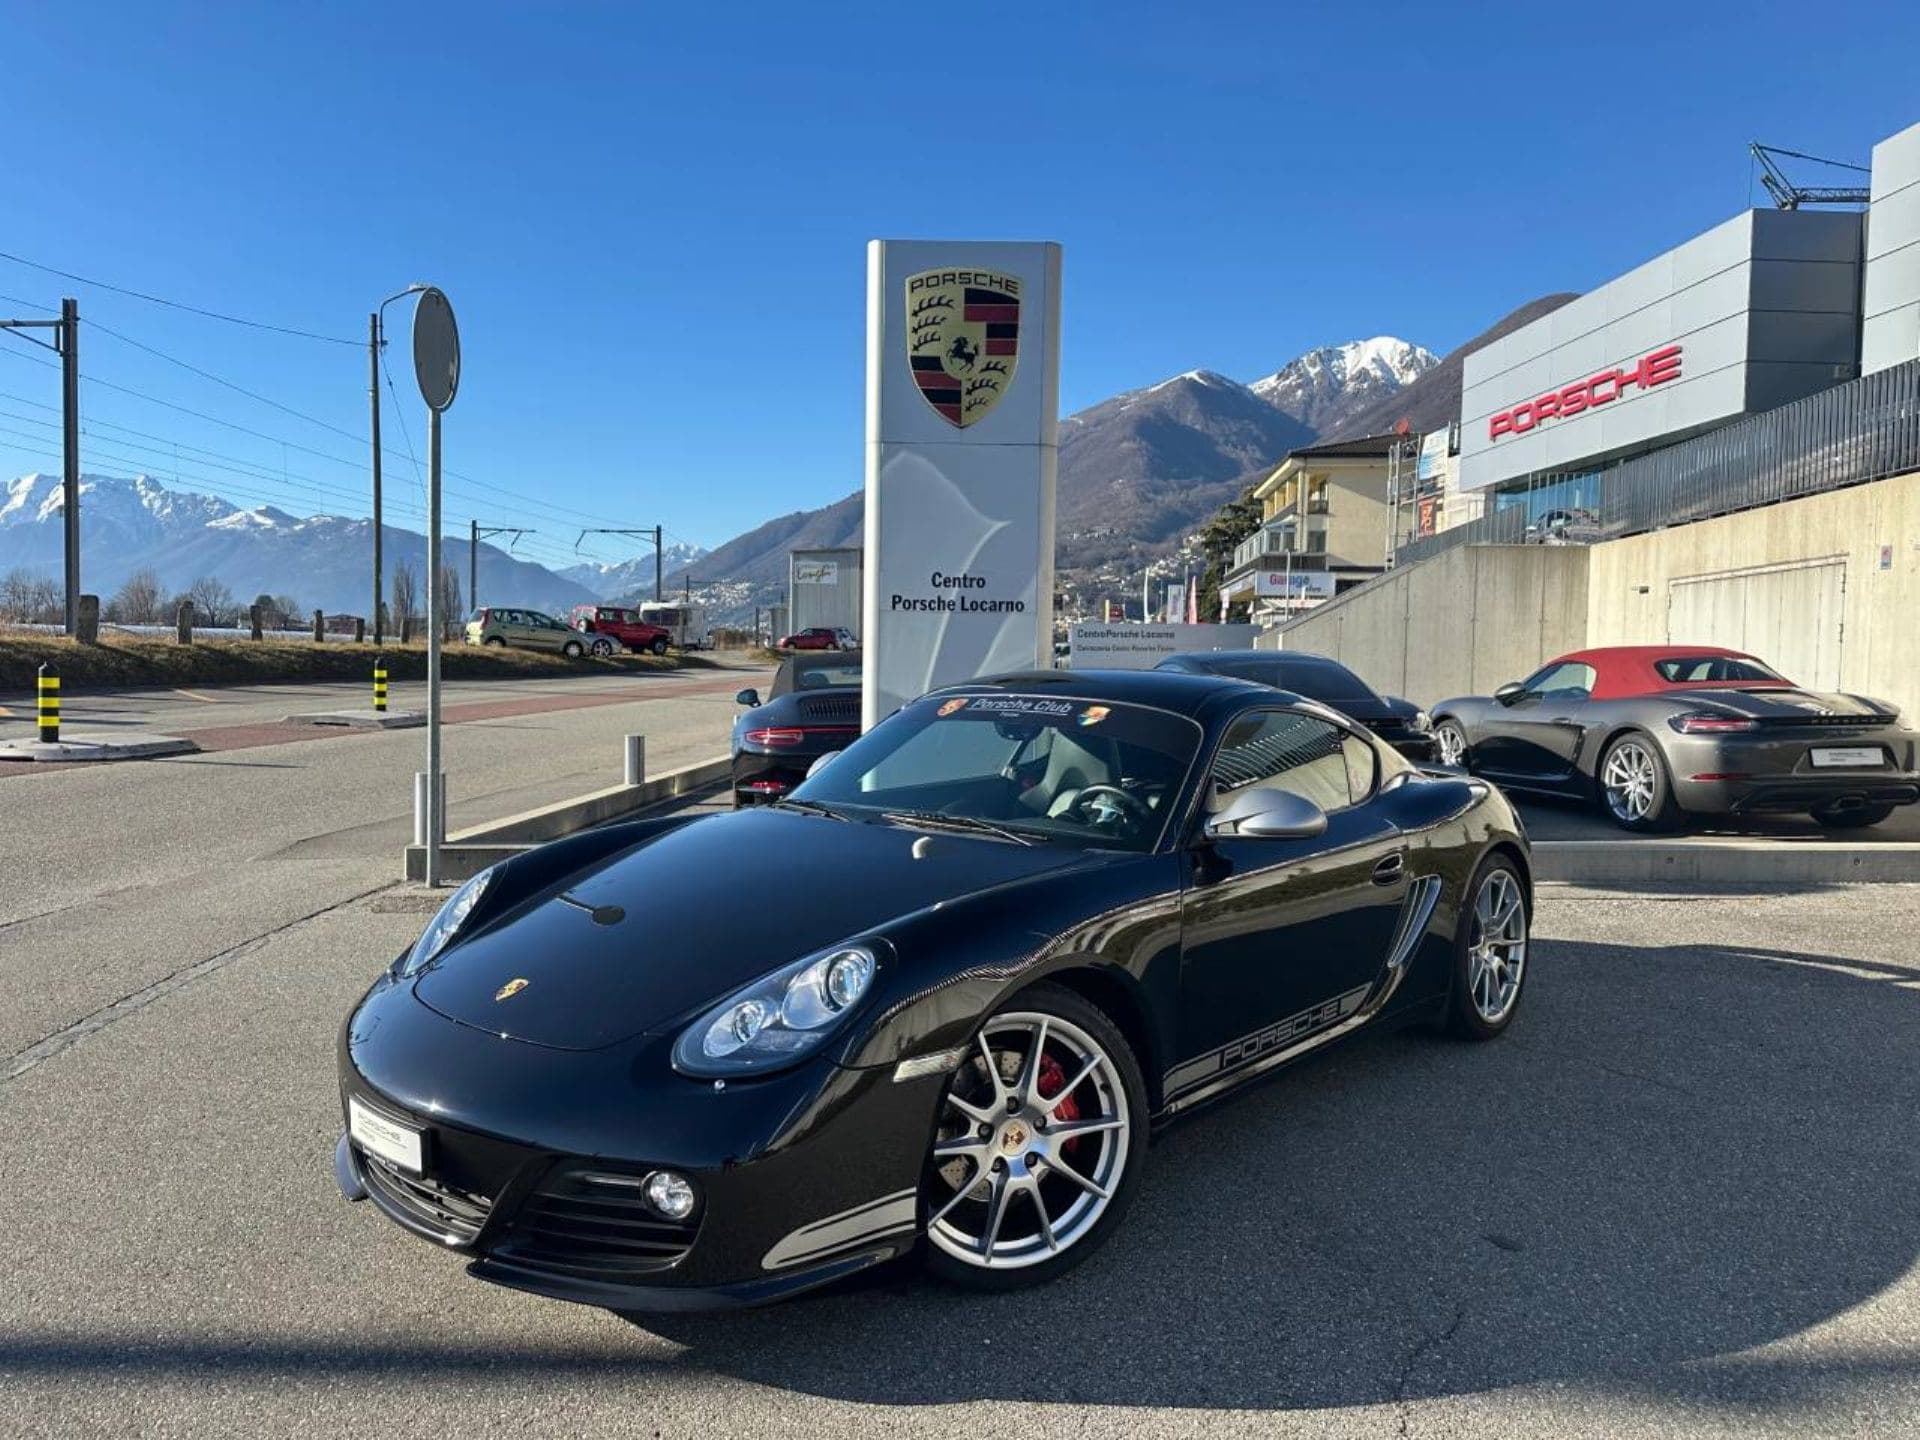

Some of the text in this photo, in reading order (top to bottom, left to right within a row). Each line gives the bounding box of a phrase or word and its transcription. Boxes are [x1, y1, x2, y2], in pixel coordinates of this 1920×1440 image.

[911, 272, 1020, 295] PORSCHE
[1489, 345, 1682, 442] PORSCHE
[931, 571, 986, 588] Centro
[891, 594, 1025, 612] Porsche Locarno
[971, 698, 1073, 713] Porsche Club
[1223, 1002, 1339, 1067] PORSCHE
